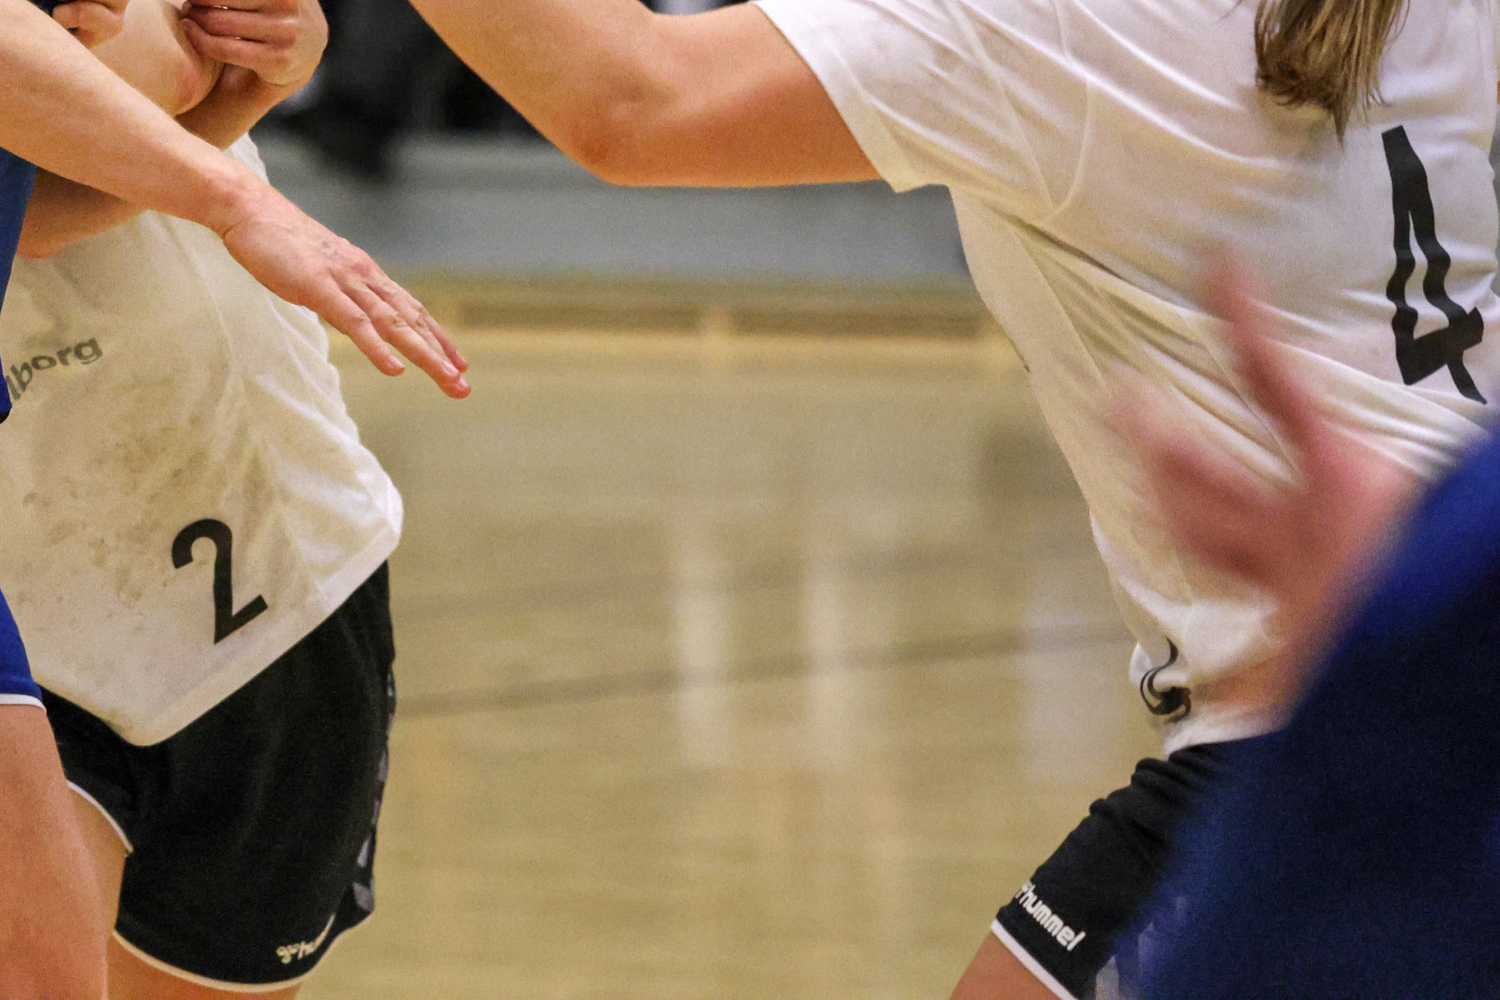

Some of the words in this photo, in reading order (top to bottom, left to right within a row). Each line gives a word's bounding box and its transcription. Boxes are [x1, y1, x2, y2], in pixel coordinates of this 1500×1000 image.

[1381, 124, 1488, 405] 4
[5, 337, 104, 401] lborg
[171, 518, 269, 645] 2
[1017, 884, 1087, 952] hummel
